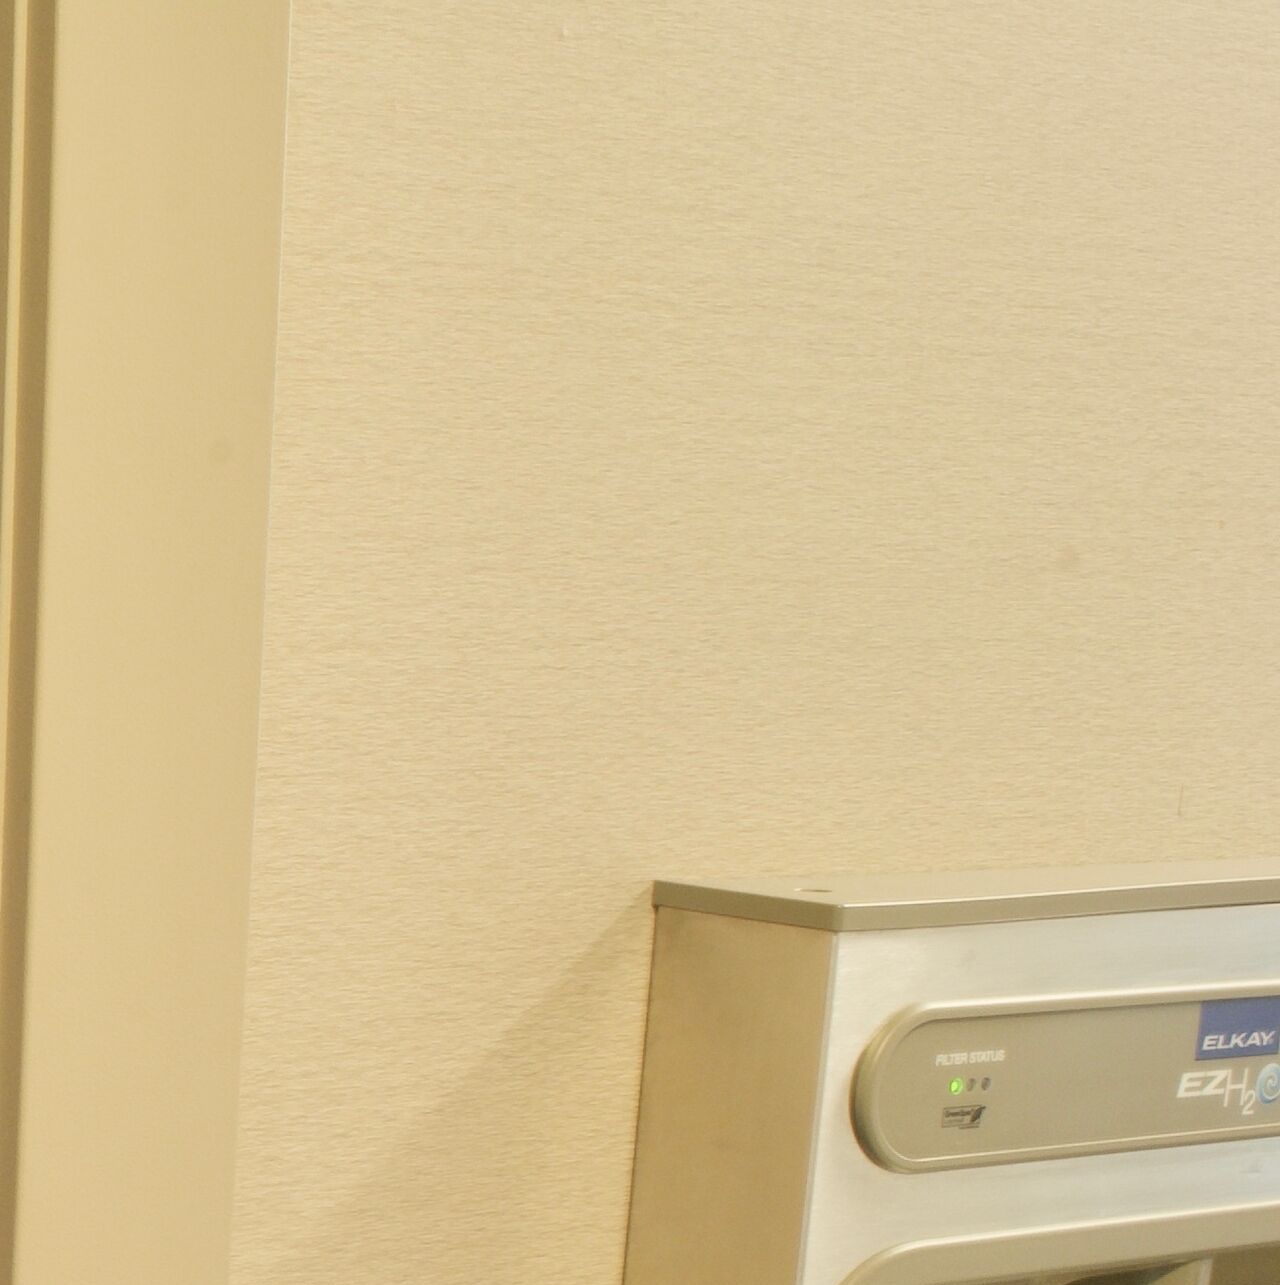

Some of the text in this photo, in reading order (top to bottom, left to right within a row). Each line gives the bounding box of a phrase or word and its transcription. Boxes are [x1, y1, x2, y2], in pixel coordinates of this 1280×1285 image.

[1202, 1030, 1276, 1051] ELKAY
[935, 1049, 1006, 1067] FILTER STATUS
